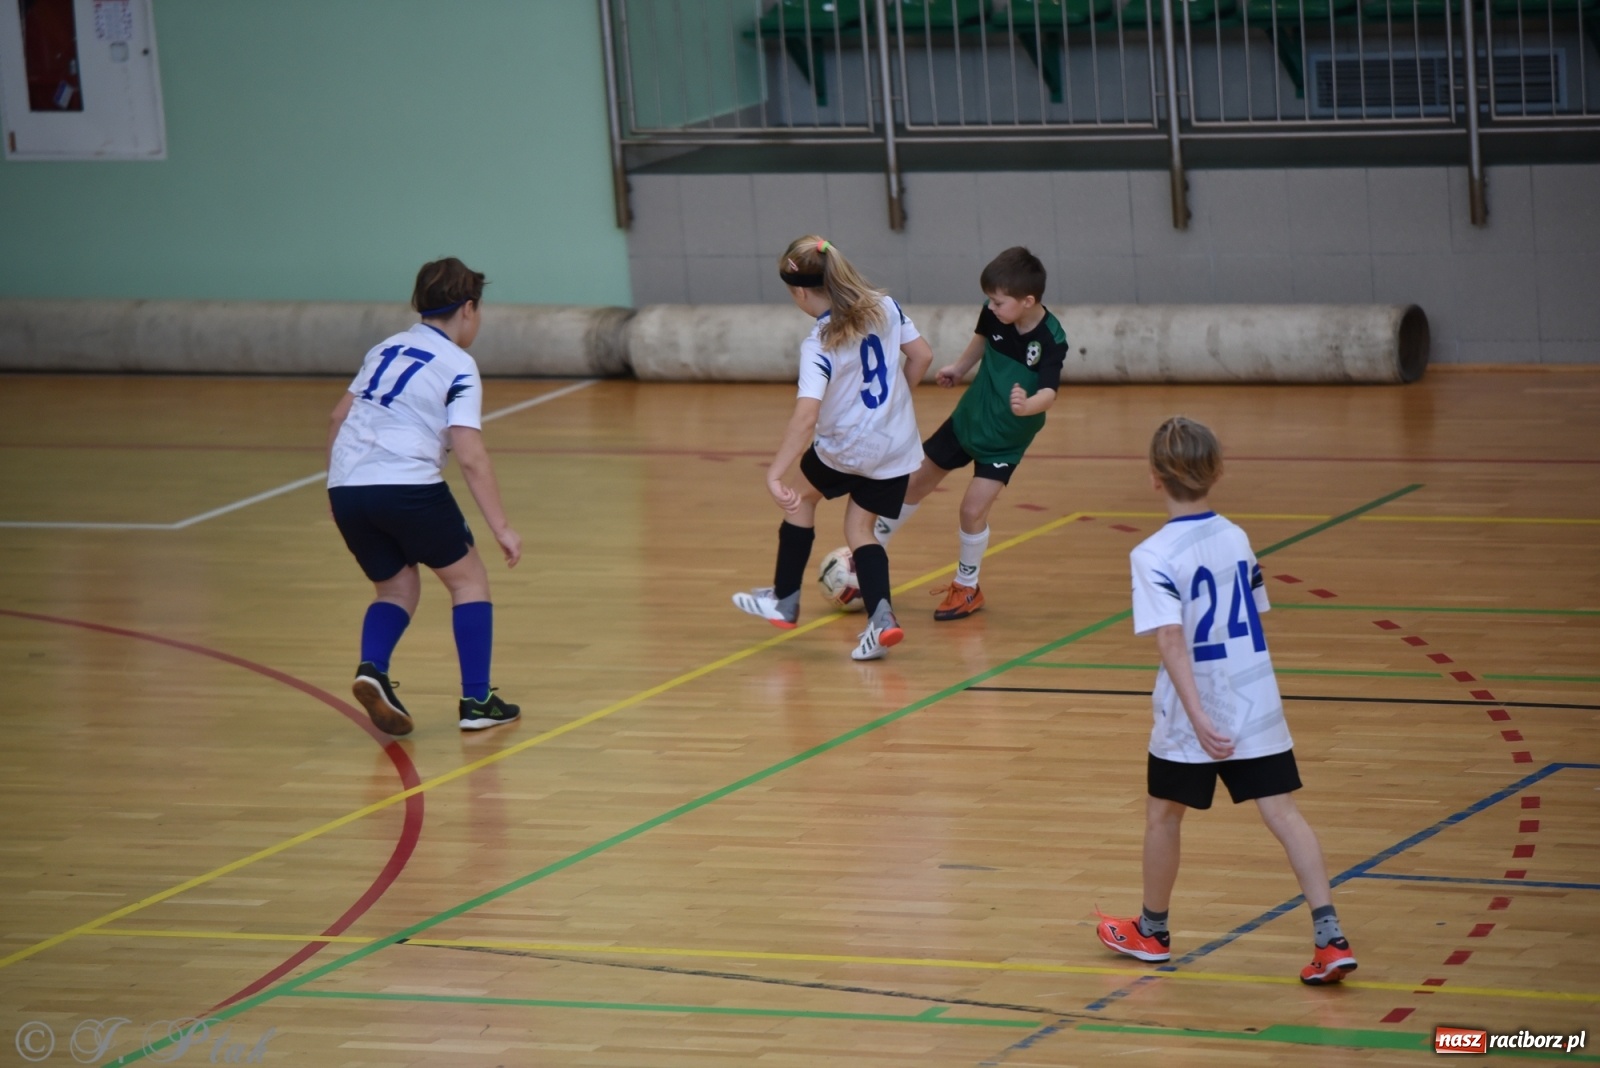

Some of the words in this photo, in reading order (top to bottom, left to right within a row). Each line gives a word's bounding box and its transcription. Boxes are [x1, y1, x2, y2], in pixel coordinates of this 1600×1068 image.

[361, 344, 436, 409] 17
[860, 333, 889, 410] 9
[1191, 560, 1267, 663] 24
